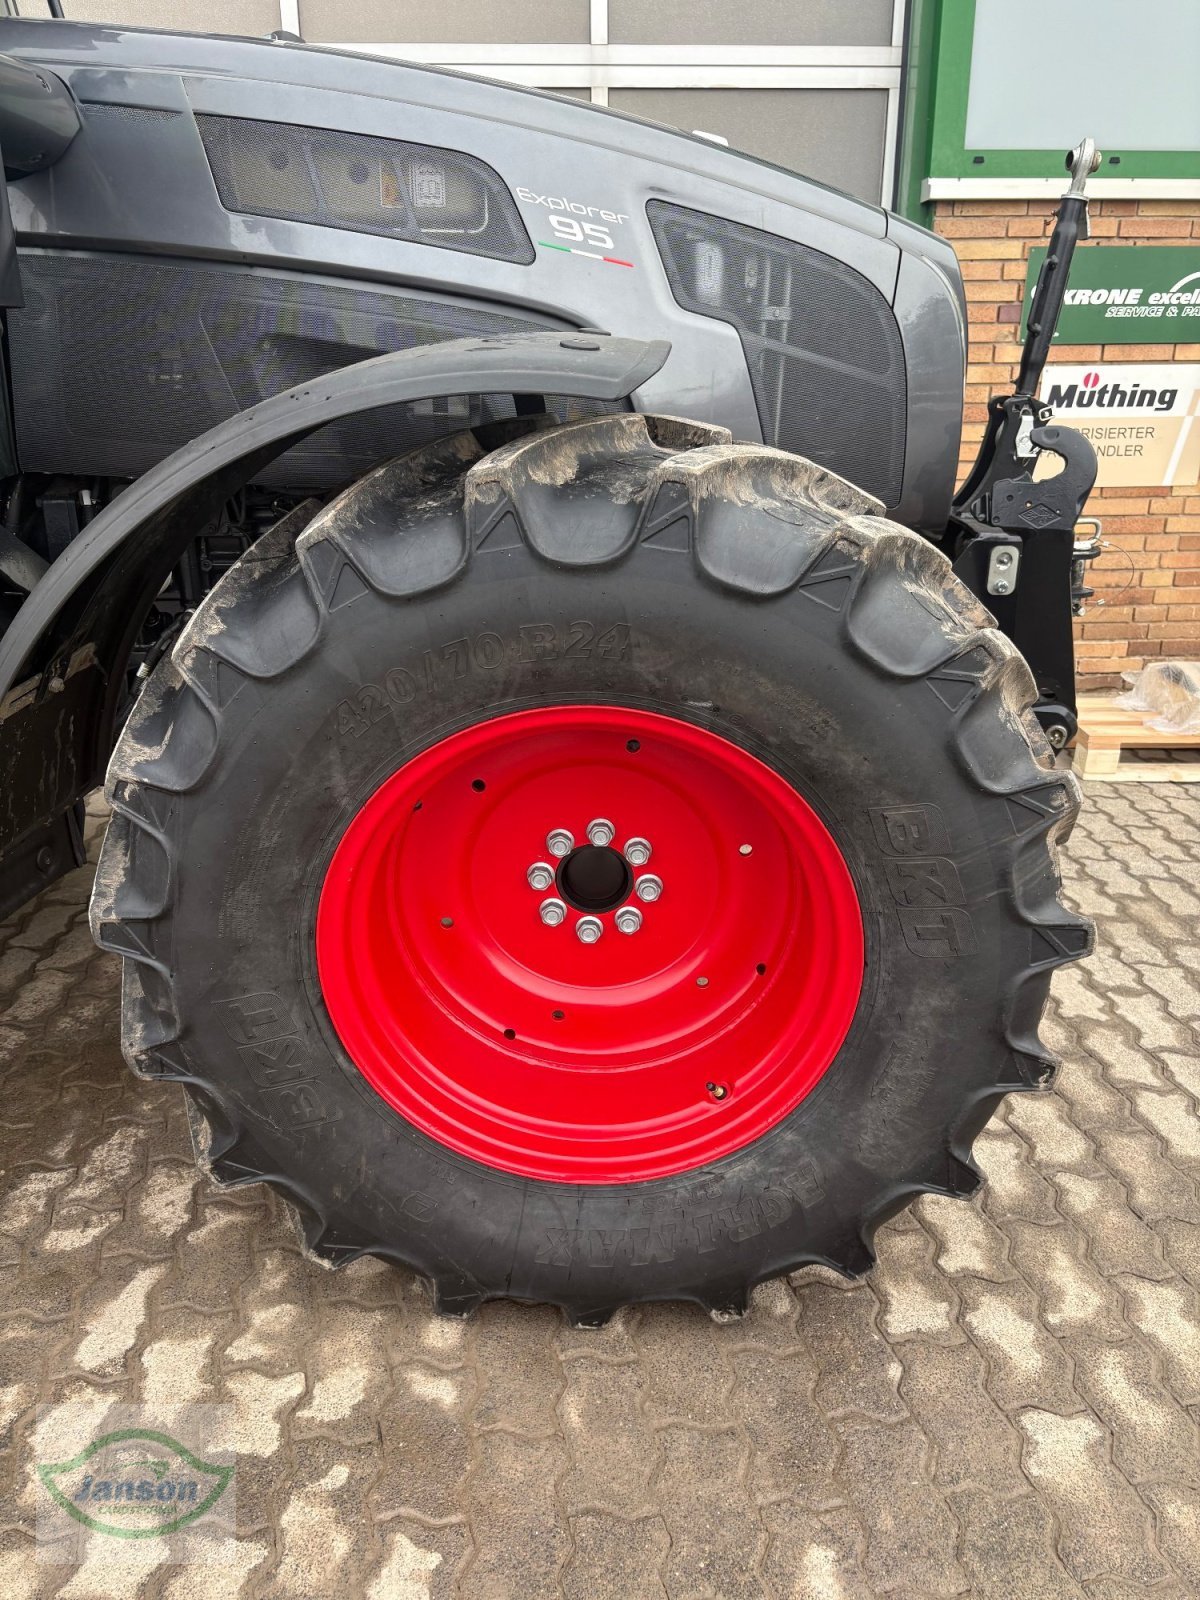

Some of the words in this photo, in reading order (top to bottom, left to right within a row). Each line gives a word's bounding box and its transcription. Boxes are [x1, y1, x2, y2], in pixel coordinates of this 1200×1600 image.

[515, 187, 630, 225] Explorer
[548, 214, 615, 250] 95
[1063, 288, 1144, 305] KRONE
[1104, 306, 1166, 318] SERVICE
[1166, 305, 1179, 317] &
[1047, 372, 1178, 412] Müthing
[1074, 426, 1156, 440] RISIERTER
[1092, 444, 1144, 457] NDLER
[335, 631, 506, 739] 420/70
[872, 804, 972, 957] BKT
[217, 995, 334, 1129] BKT
